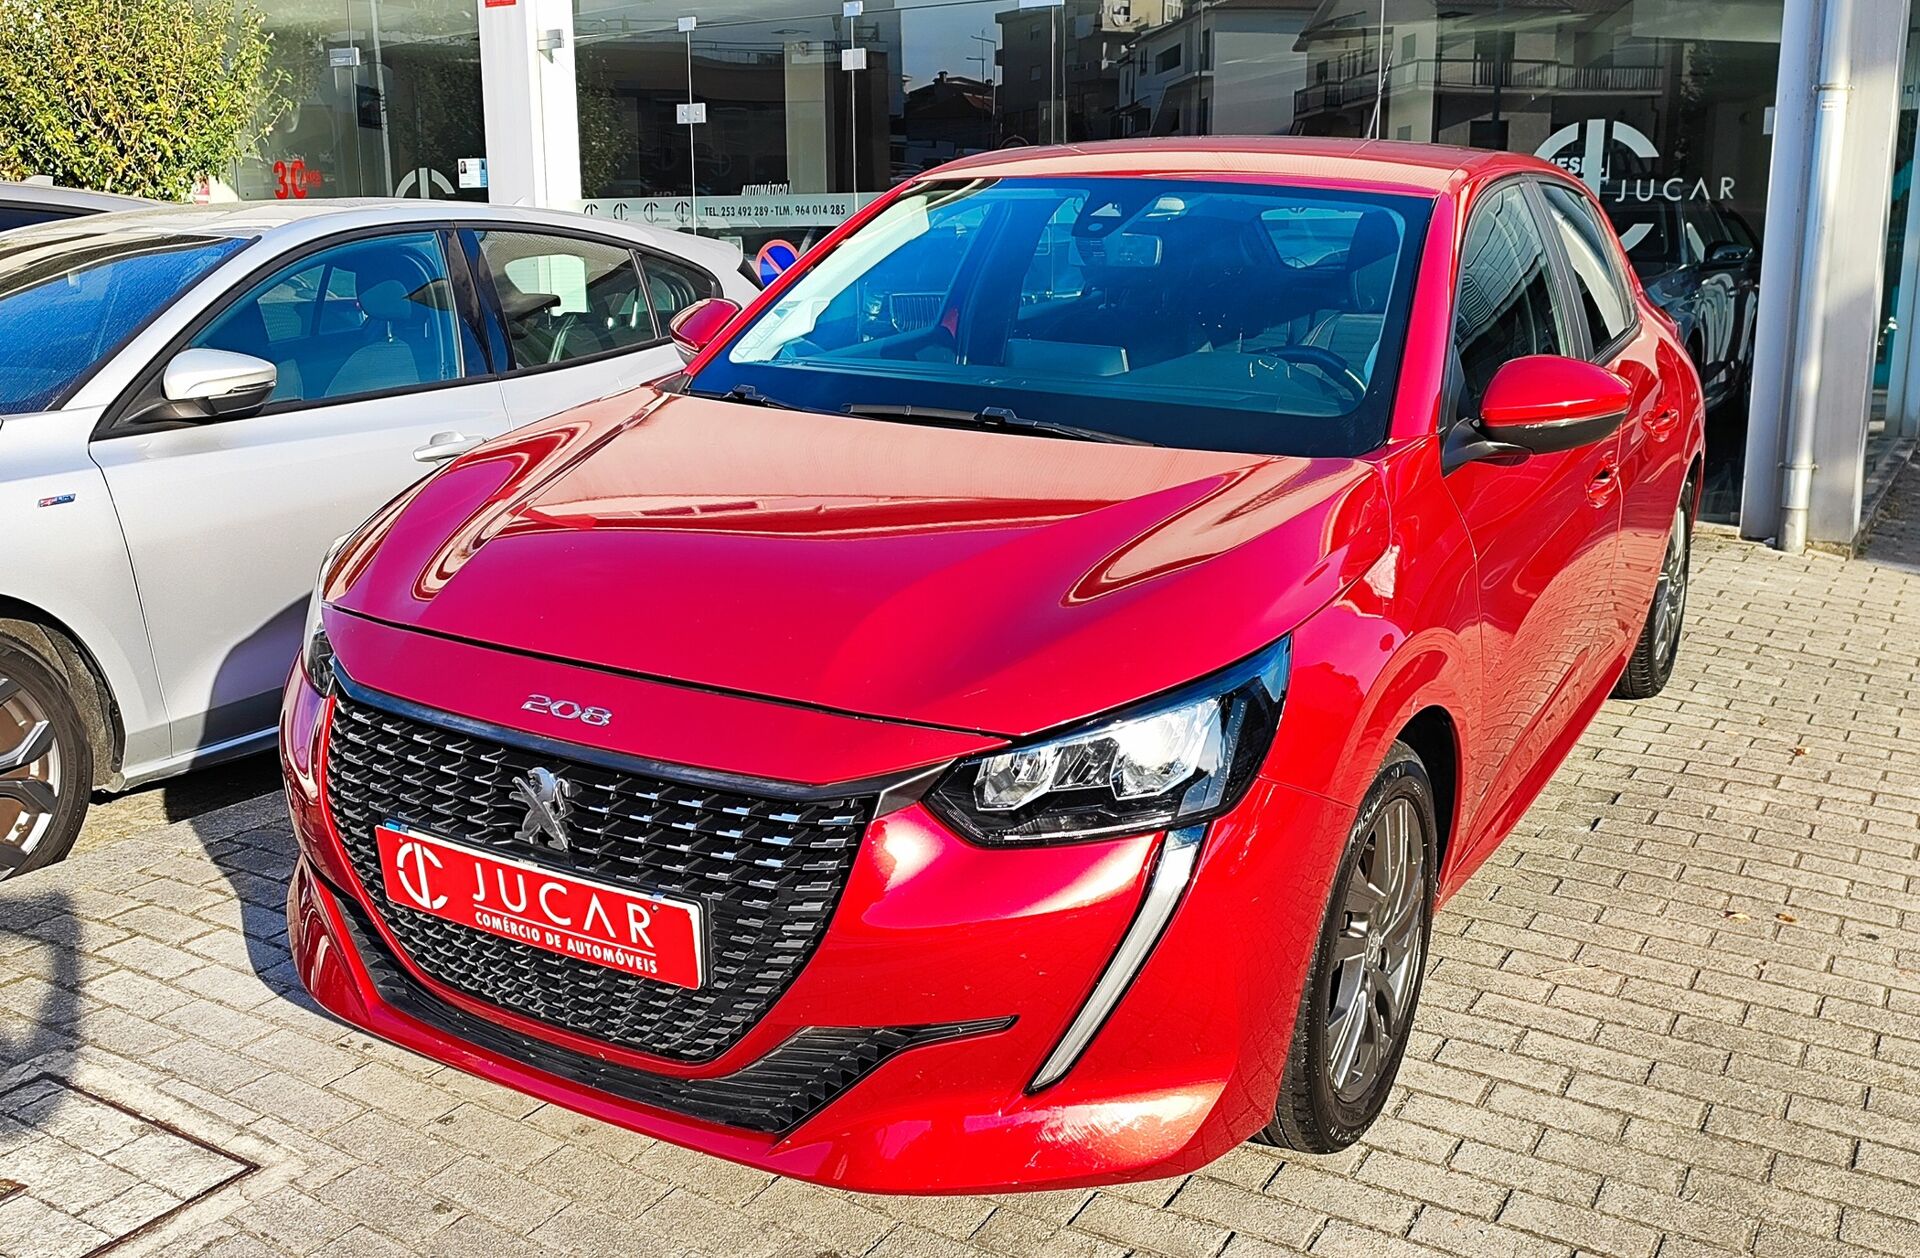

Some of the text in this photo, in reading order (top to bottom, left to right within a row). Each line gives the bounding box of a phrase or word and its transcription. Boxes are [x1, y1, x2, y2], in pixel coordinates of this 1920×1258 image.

[741, 181, 789, 197] AUTOMÁTICO
[1615, 176, 1736, 202] JUCAR
[704, 206, 719, 217] TEL.
[721, 206, 736, 217] 253
[737, 205, 752, 217] 492
[754, 205, 769, 217] 289
[775, 205, 793, 216] TLM.
[795, 205, 810, 215] 964
[812, 204, 827, 215] 014
[830, 204, 846, 215] 285
[521, 694, 613, 726] 208
[472, 862, 655, 948] JUCAR
[474, 911, 658, 974] COMÉRCIO DE AUTOMÓVEIS
